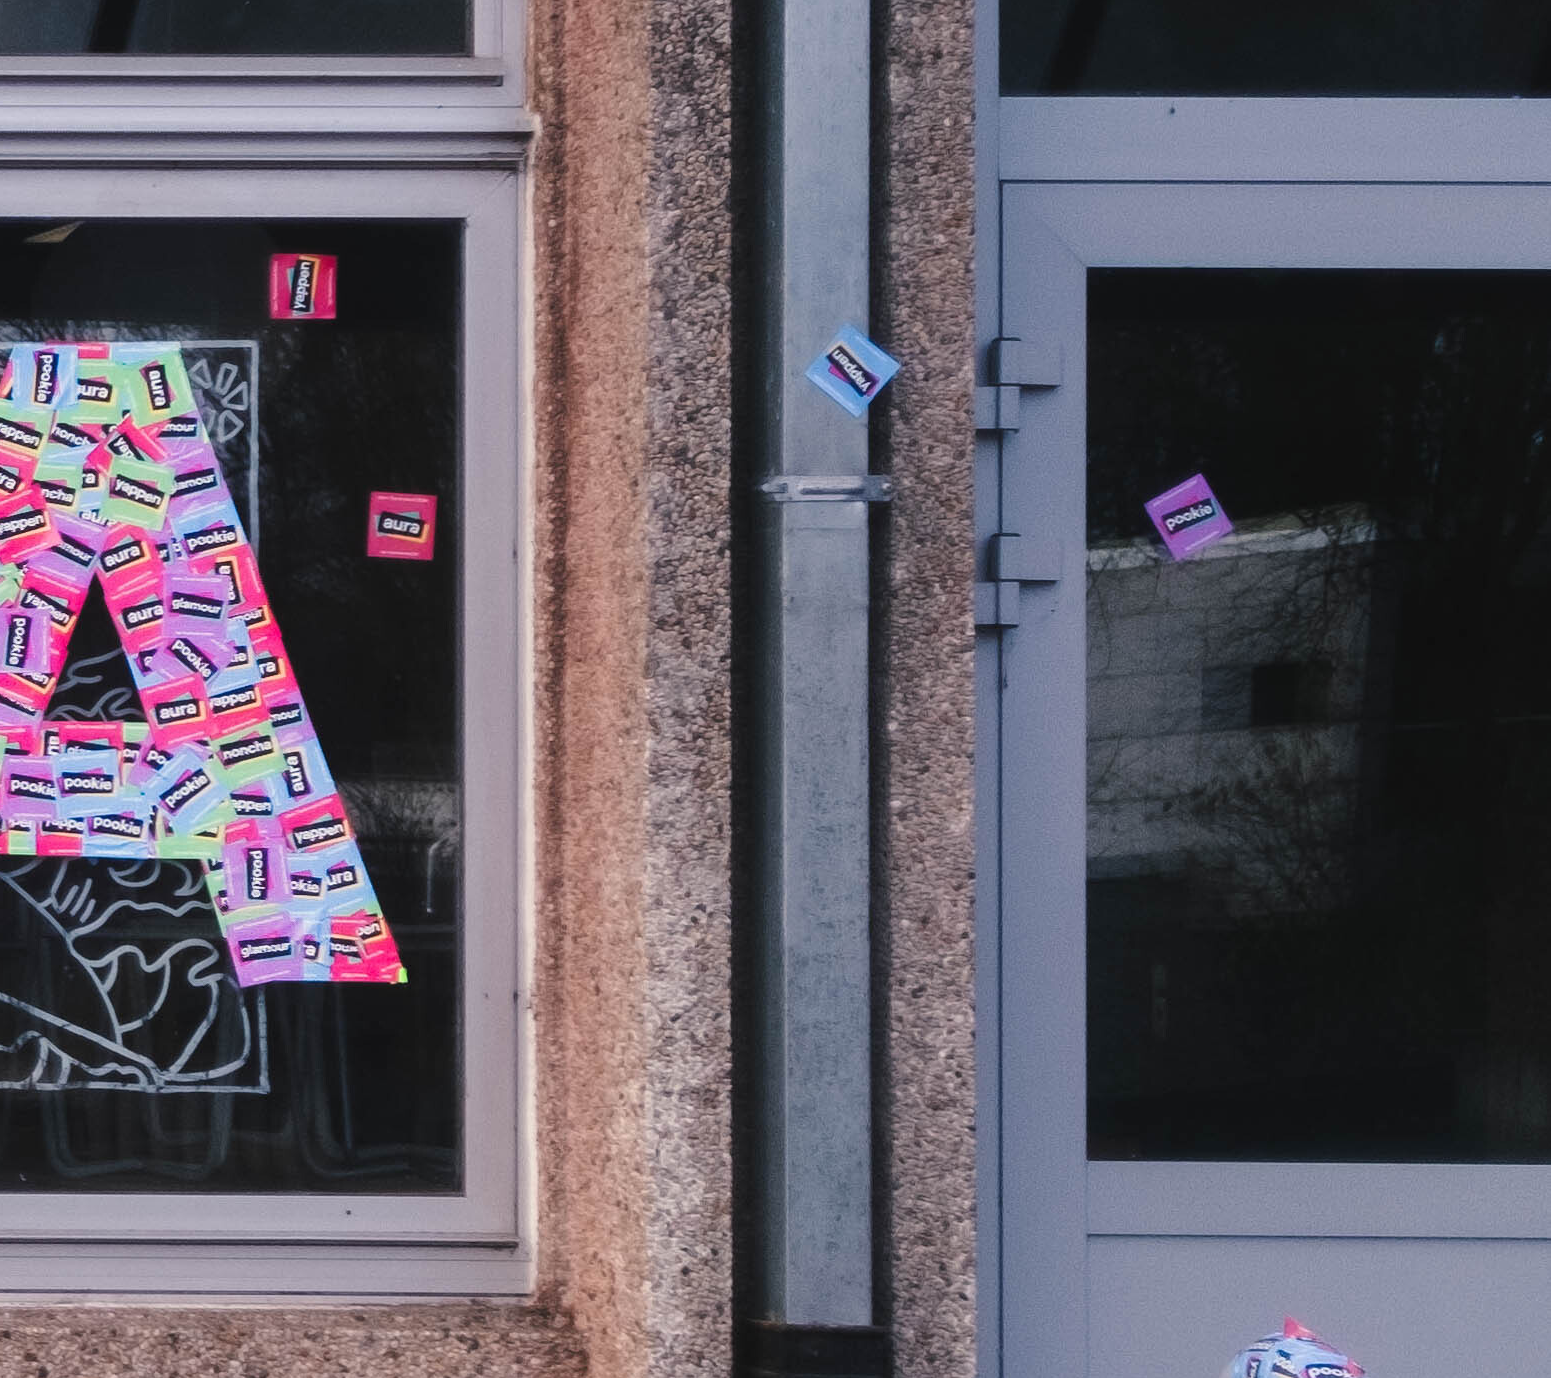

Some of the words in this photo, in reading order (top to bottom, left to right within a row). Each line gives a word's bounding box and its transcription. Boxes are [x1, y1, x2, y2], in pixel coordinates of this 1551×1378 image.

[293, 262, 311, 309] yappen
[833, 350, 871, 392] yappen
[149, 370, 166, 406] aura
[115, 479, 162, 505] yappen
[383, 518, 420, 534] aura
[1165, 505, 1212, 531] pookie
[104, 546, 140, 567] aura
[160, 703, 197, 719] aura
[222, 741, 269, 761] noncha
[294, 824, 344, 844] yappen
[249, 850, 265, 898] pookie
